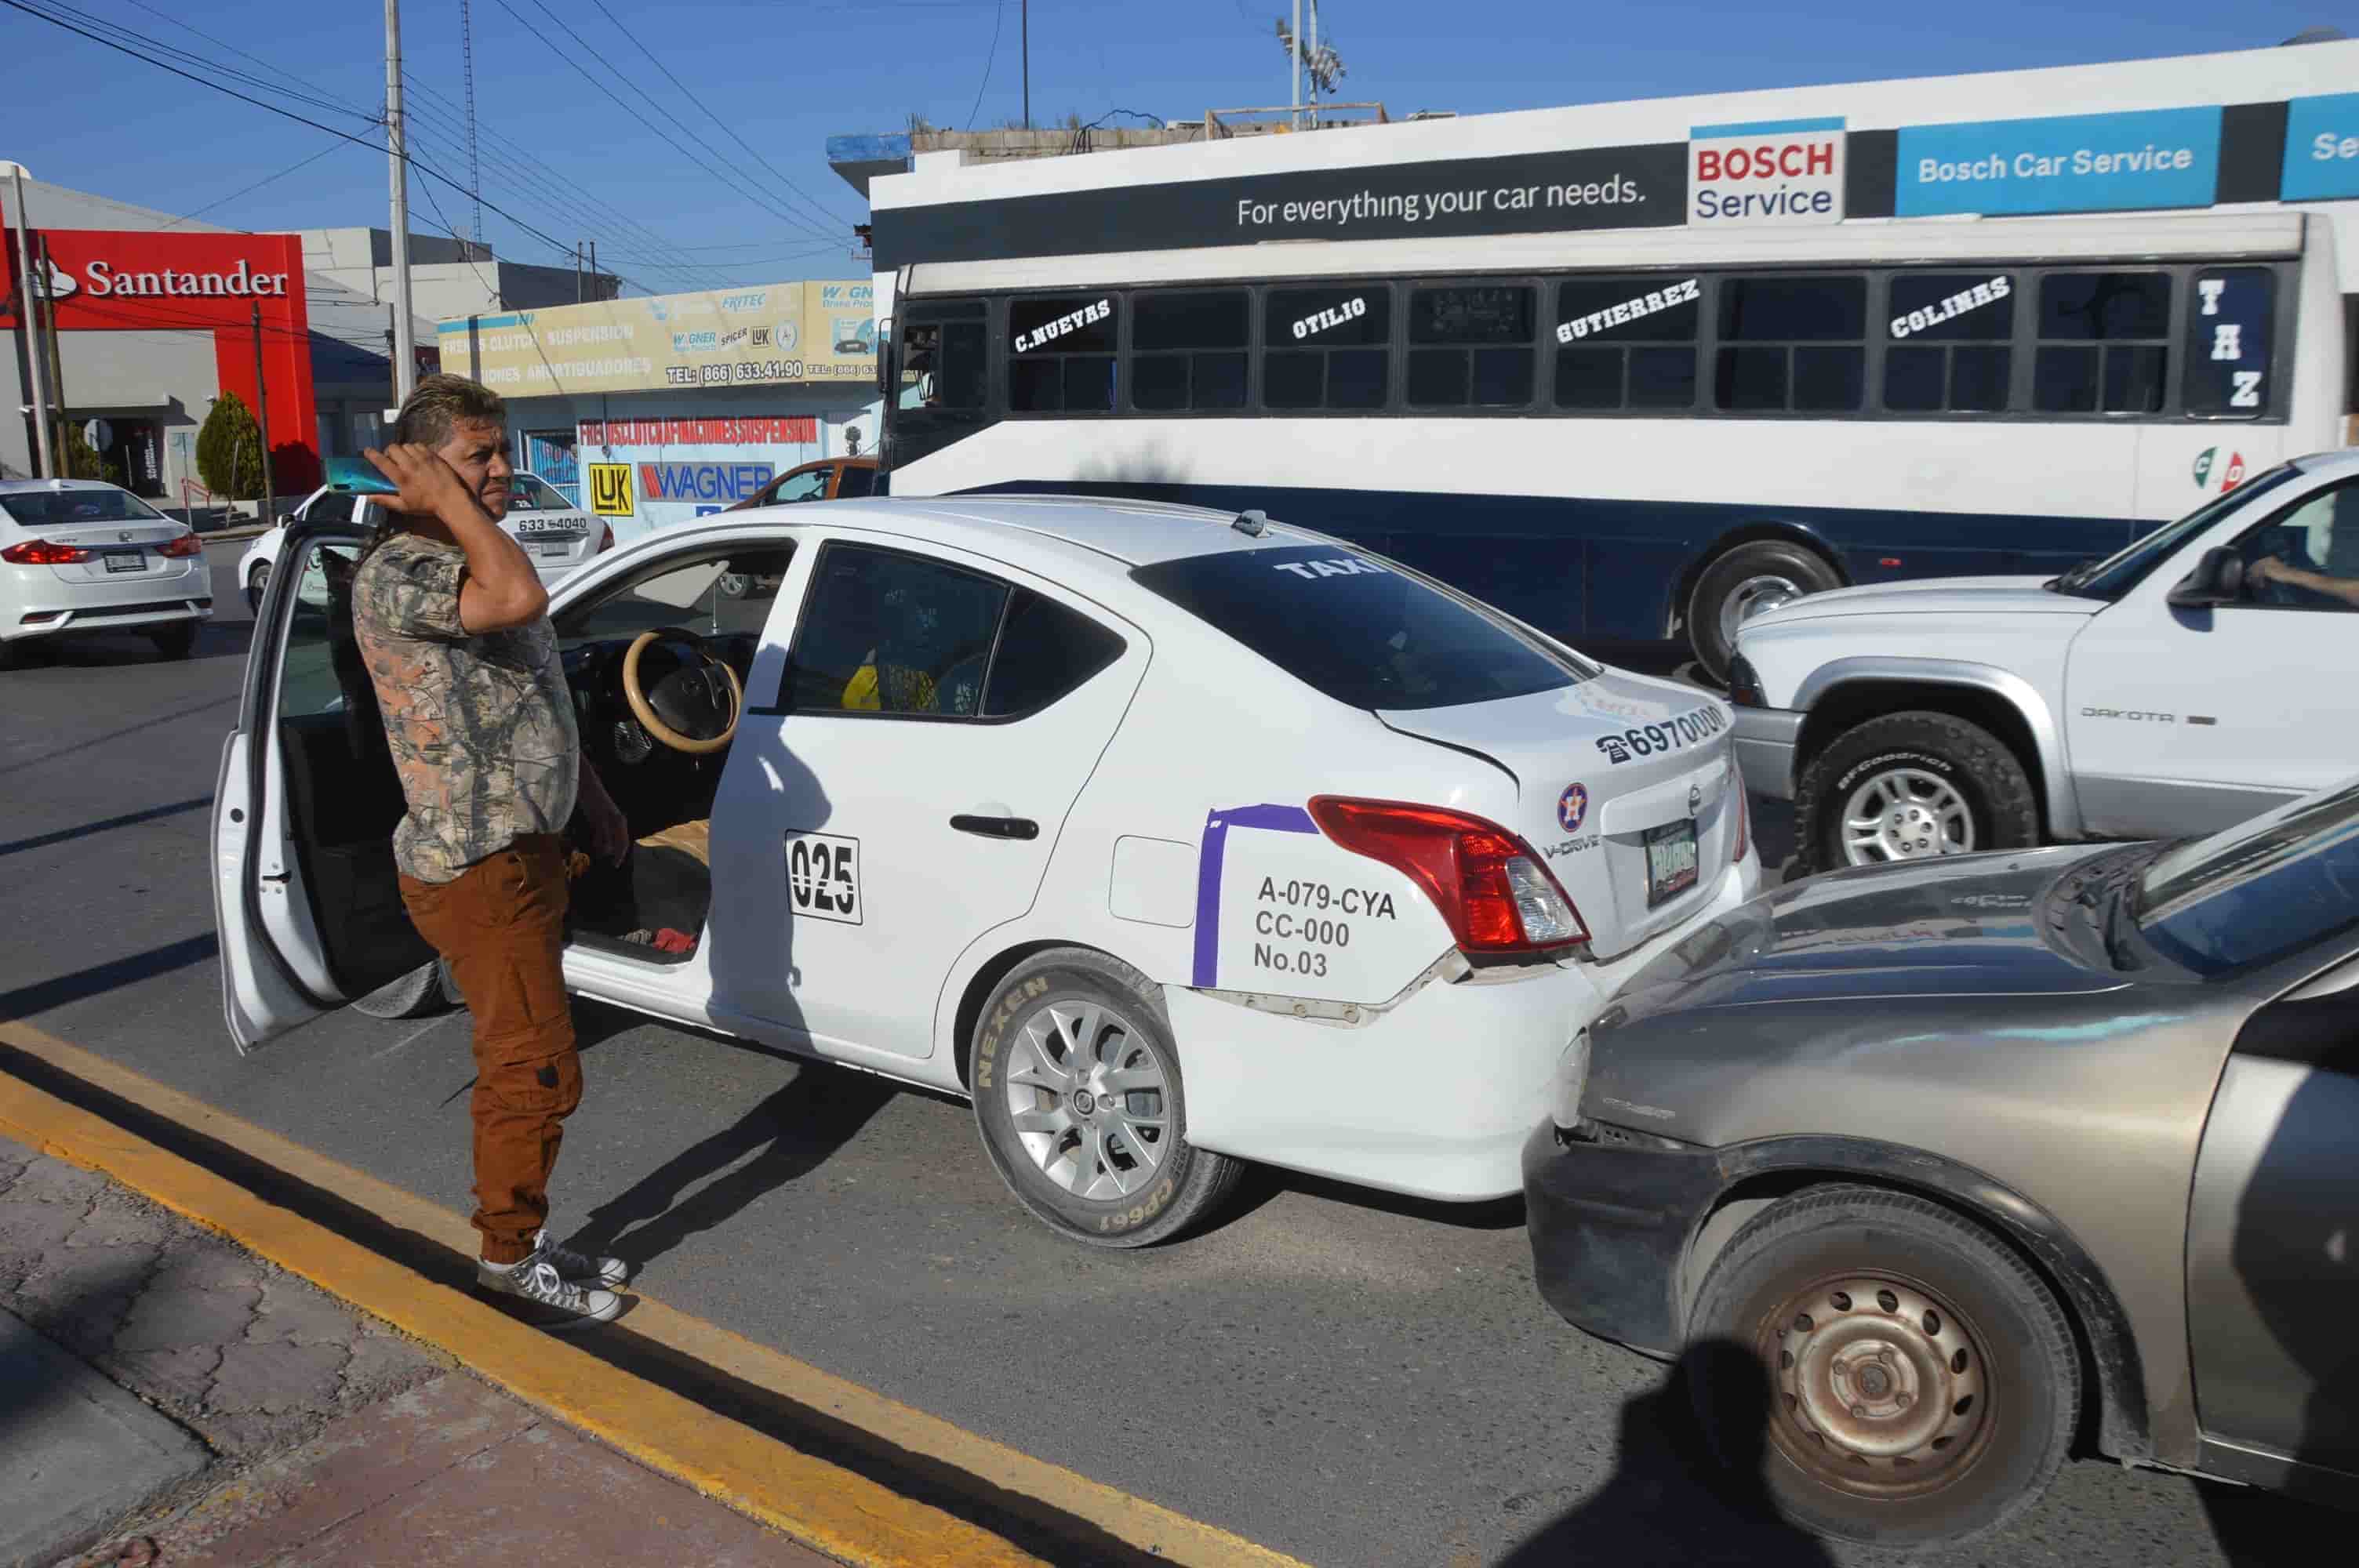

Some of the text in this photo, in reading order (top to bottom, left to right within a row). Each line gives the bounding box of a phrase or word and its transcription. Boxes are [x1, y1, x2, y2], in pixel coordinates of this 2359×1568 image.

[1697, 143, 1834, 182] BOSCH
[1918, 143, 2194, 183] Bosch Car Service
[1238, 173, 1646, 226] For everything your car needs.
[1695, 183, 1833, 220] Service
[86, 260, 288, 297] Santander
[1292, 296, 1366, 340] OTILIO
[1556, 278, 1702, 345] GUTIERREZ
[1890, 275, 2012, 339] COLINAS
[443, 336, 485, 354] FRENS
[666, 359, 803, 384] TEL: (866) 633.41.90
[519, 517, 587, 532] 633 4040
[791, 840, 855, 915] 025
[1257, 876, 1398, 921] A-079-CYA
[1256, 909, 1350, 948] CC-000
[1255, 942, 1328, 978] No.03
[977, 976, 1050, 1089] NEXEN
